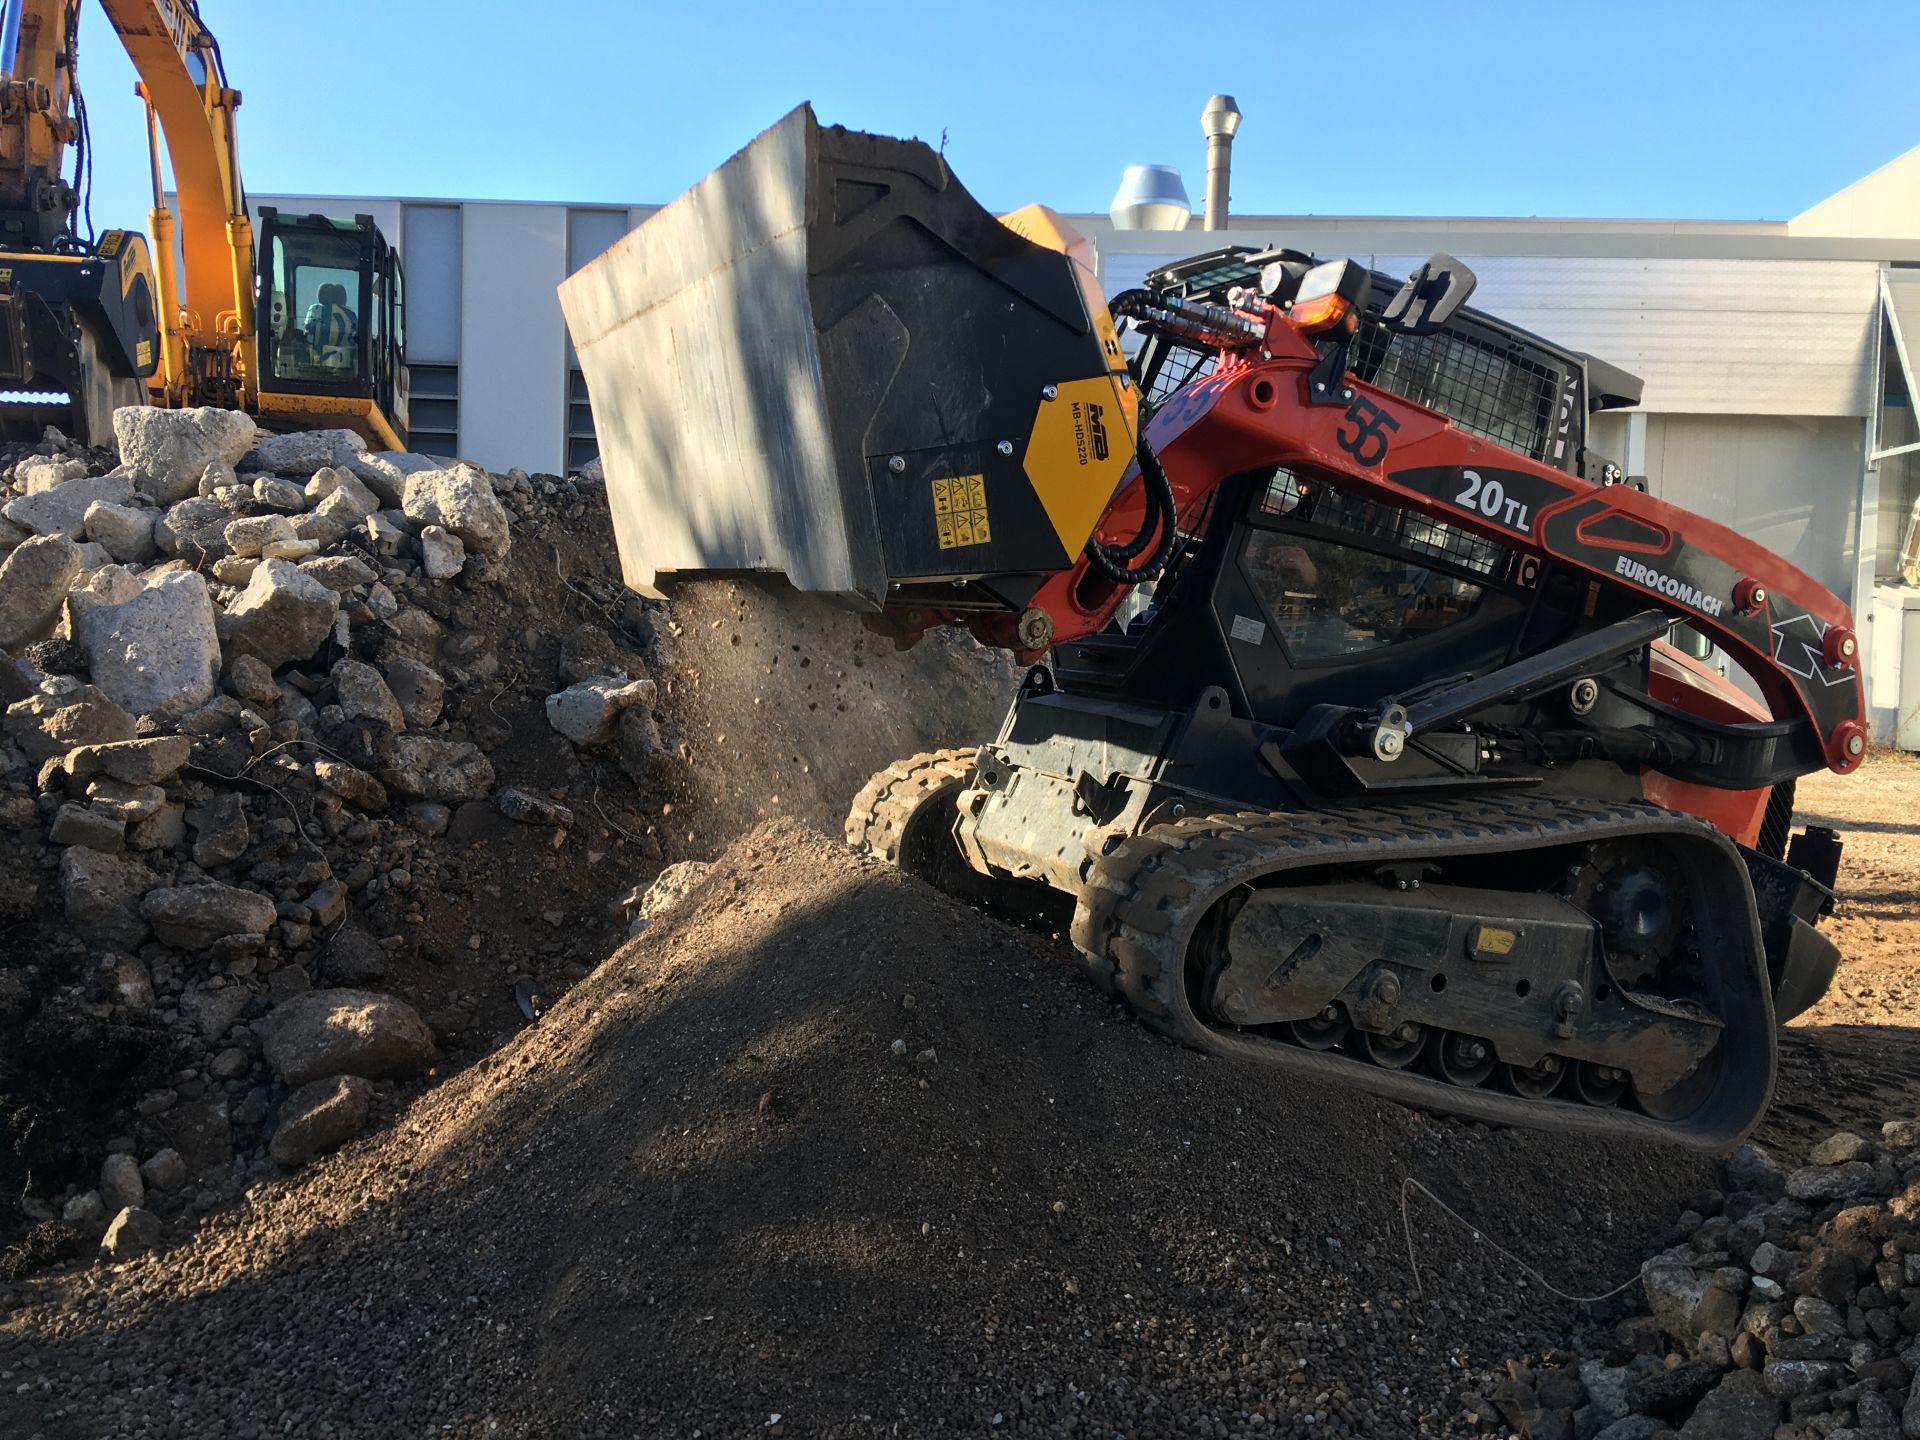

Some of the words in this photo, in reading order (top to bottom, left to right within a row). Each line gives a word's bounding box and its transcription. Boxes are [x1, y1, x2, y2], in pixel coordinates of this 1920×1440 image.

[1071, 402, 1088, 466] MB-HDS220
[1336, 395, 1401, 467] 55
[1455, 470, 1530, 532] 20TL
[1615, 555, 1723, 617] EUROCOMACH
